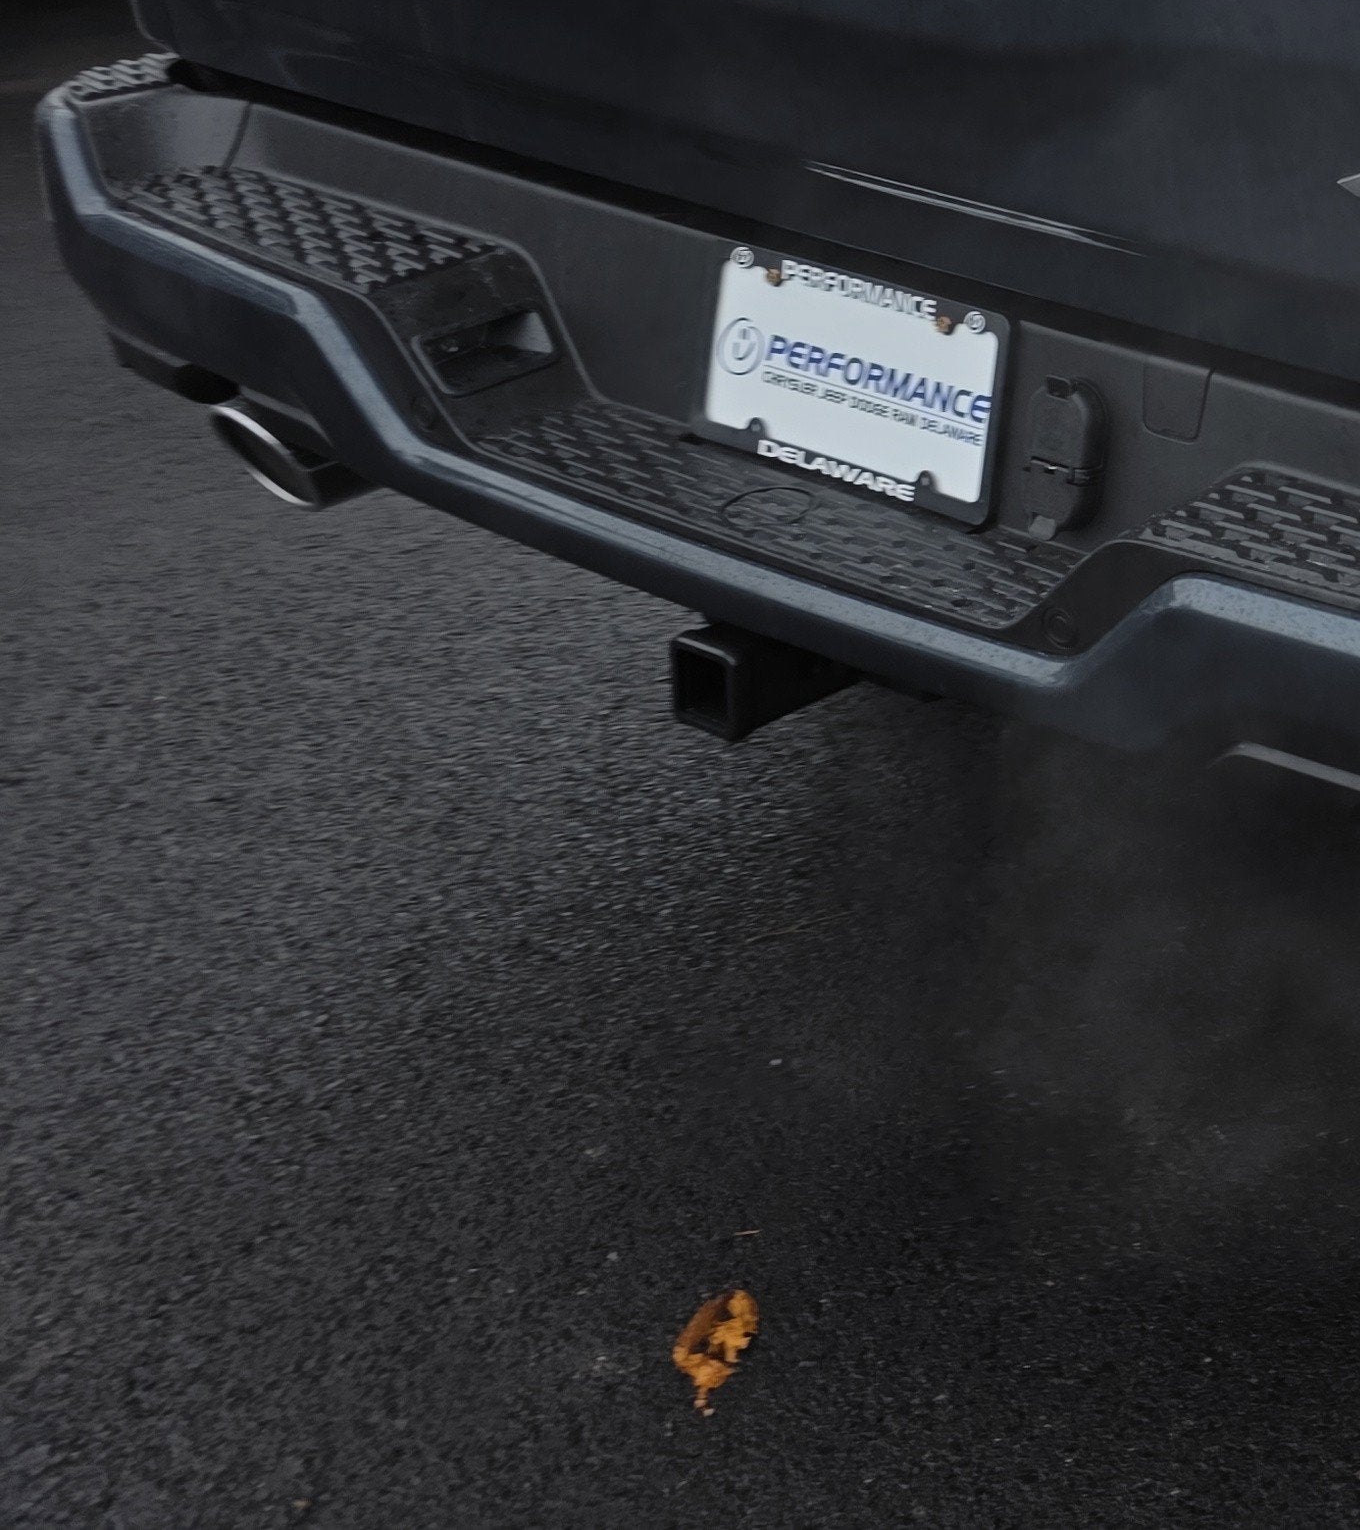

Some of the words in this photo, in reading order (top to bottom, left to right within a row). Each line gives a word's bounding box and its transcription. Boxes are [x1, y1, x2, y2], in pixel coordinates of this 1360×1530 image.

[781, 259, 937, 321] PERFORMANCE
[765, 334, 993, 424] PERFORMANCE
[757, 439, 915, 502] DELAWARE
